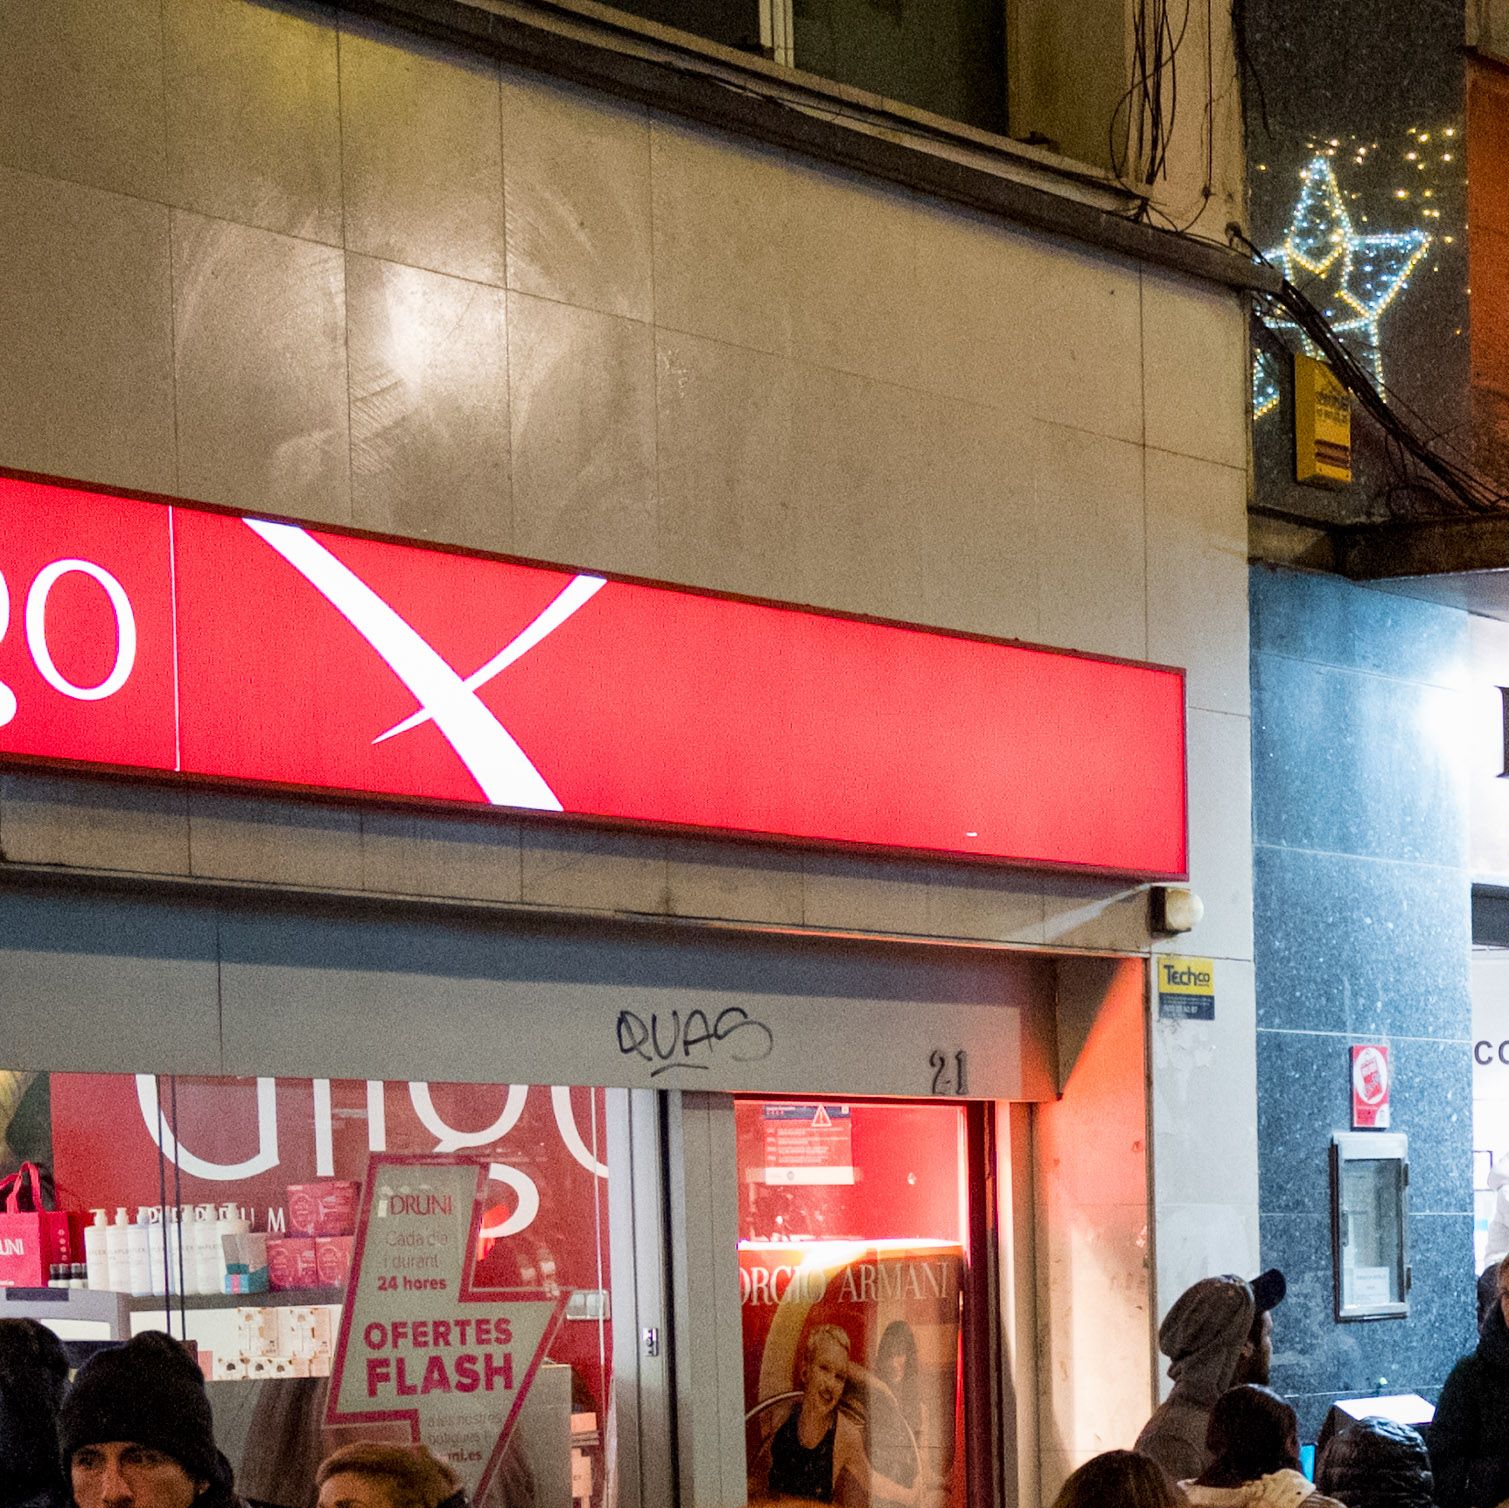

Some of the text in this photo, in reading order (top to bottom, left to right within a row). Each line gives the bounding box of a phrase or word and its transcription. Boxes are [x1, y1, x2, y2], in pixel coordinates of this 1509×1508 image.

[929, 1049, 969, 1096] 21
[390, 1195, 452, 1216] DRUNI
[377, 1275, 448, 1292] 24 hores
[837, 1261, 949, 1303] ARMANI
[363, 1317, 513, 1351] OFERTES
[366, 1352, 513, 1399] FLASH
